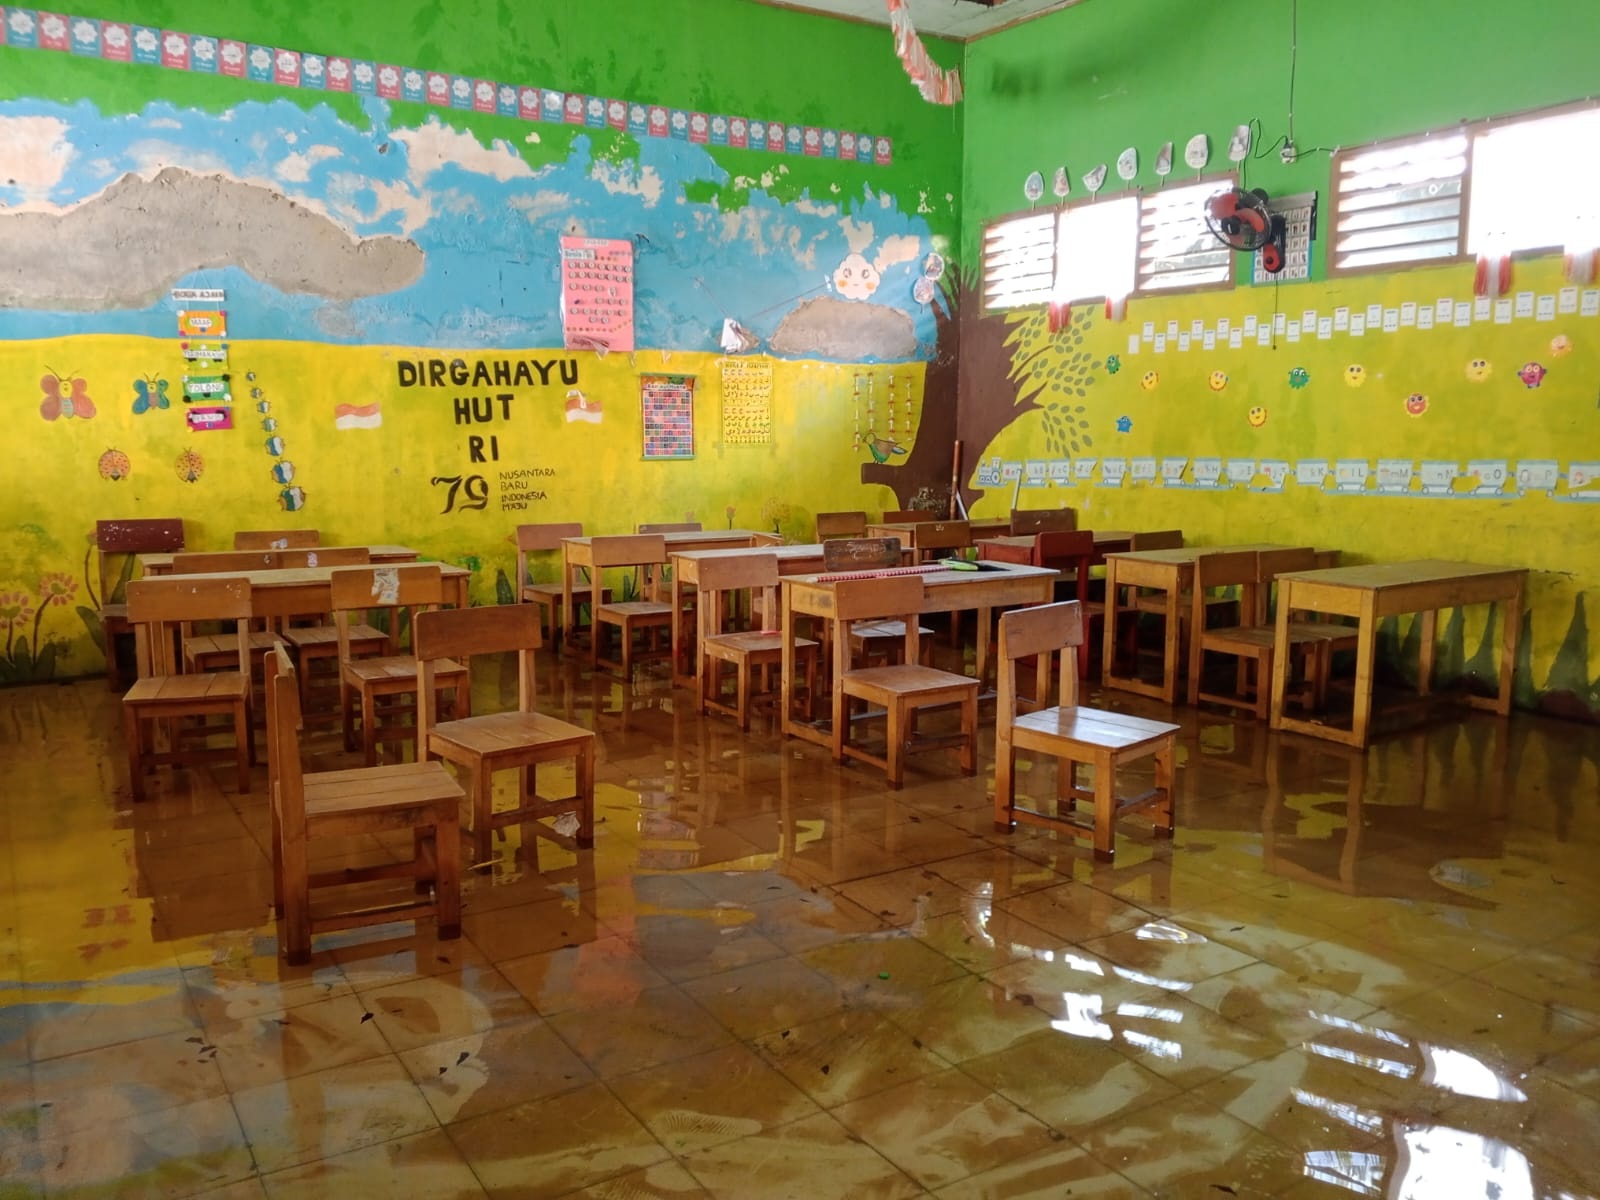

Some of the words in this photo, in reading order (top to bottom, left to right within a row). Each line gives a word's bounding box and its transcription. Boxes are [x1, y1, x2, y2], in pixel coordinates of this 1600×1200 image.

[397, 359, 578, 387] DIRGAHAYU
[453, 394, 514, 425] HUT
[469, 435, 499, 463] RI
[499, 468, 555, 480] NUSANTARA
[431, 475, 489, 515] 79
[500, 481, 528, 491] BARU
[501, 491, 548, 503] INDONESIA
[502, 502, 528, 512] MAJU
